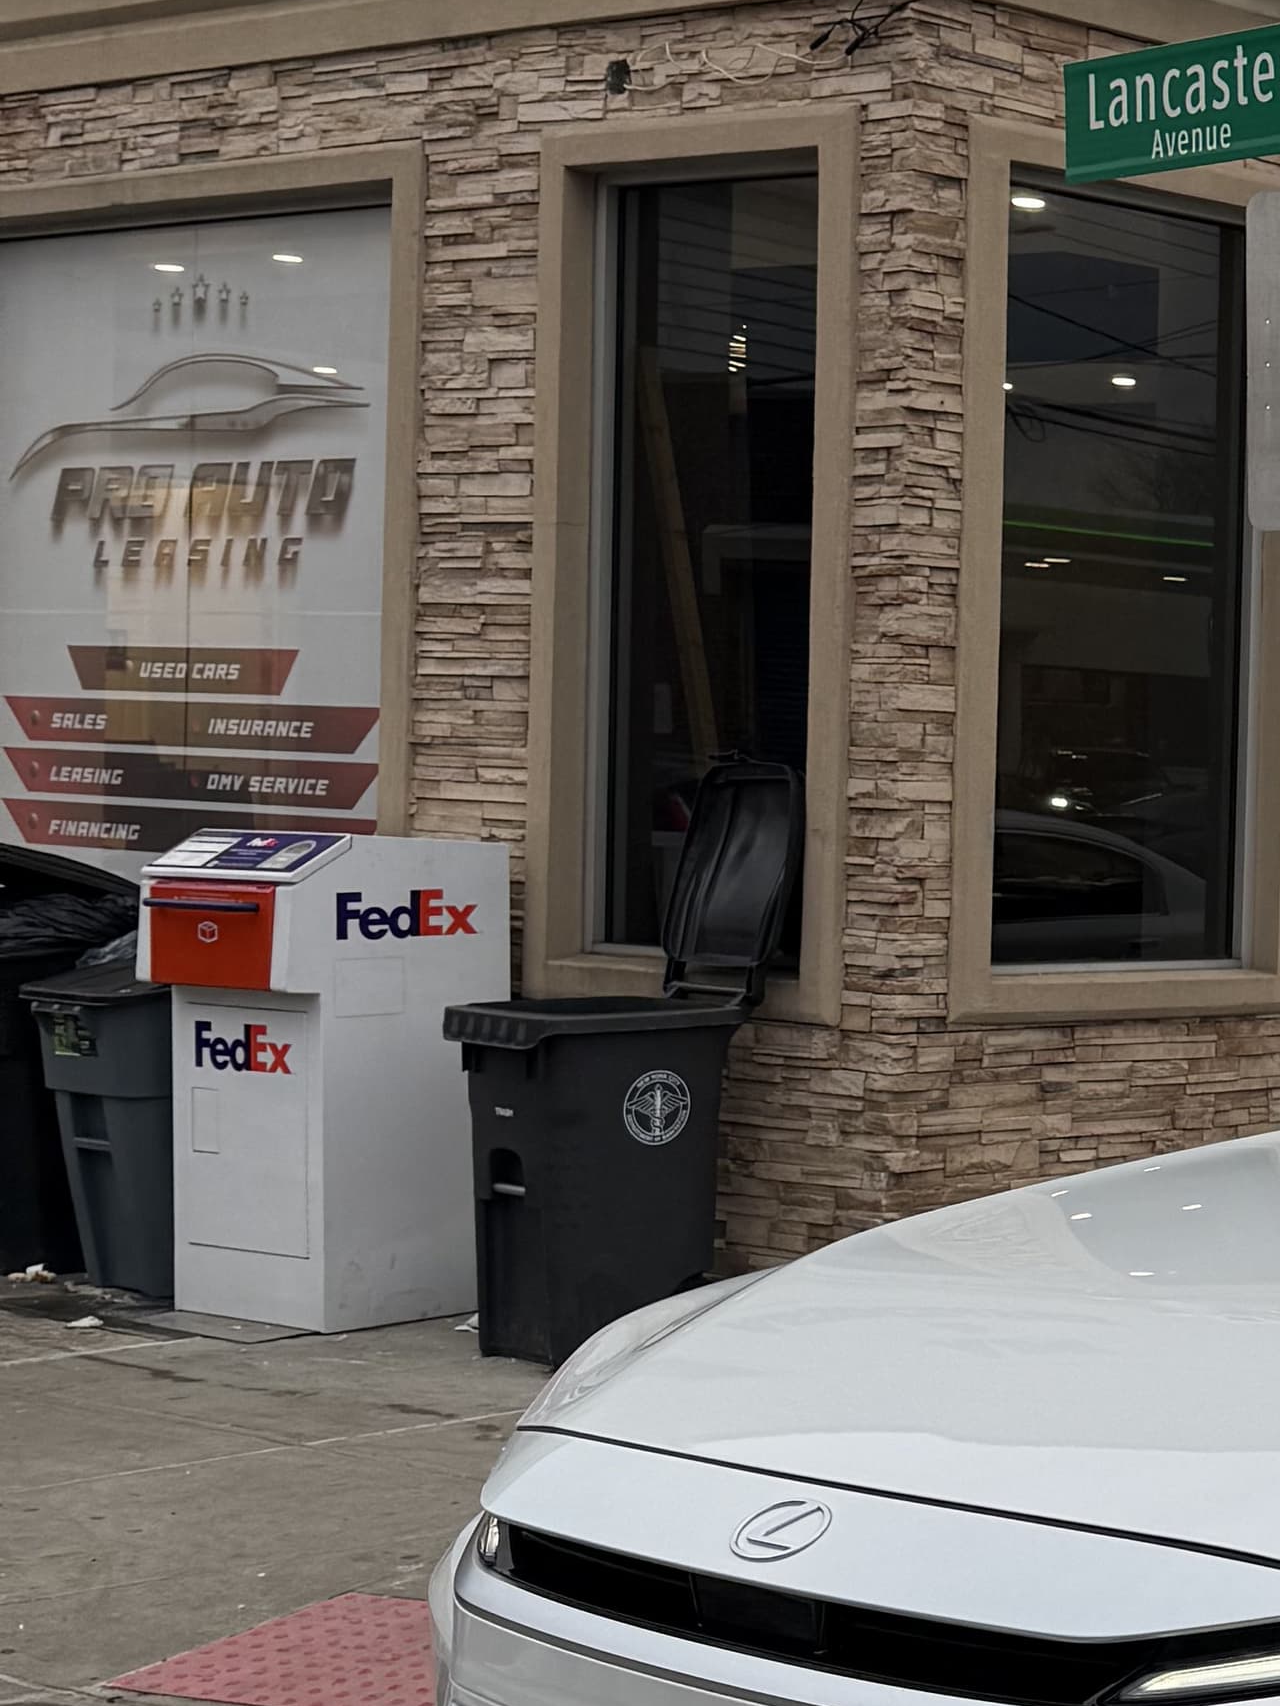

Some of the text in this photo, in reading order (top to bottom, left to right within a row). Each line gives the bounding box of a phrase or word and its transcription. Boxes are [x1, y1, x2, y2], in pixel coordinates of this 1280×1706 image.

[1151, 120, 1232, 160] Avenue
[51, 458, 356, 519] PRO AUTO
[93, 537, 303, 568] LEASING
[139, 661, 241, 681] USED CARS
[50, 712, 314, 739] SALES INSURANCE
[49, 765, 330, 796] LEASING DMV SERVICE
[48, 819, 141, 841] FINANCING
[336, 889, 478, 940] FedEx
[195, 1021, 292, 1075] FedEx
